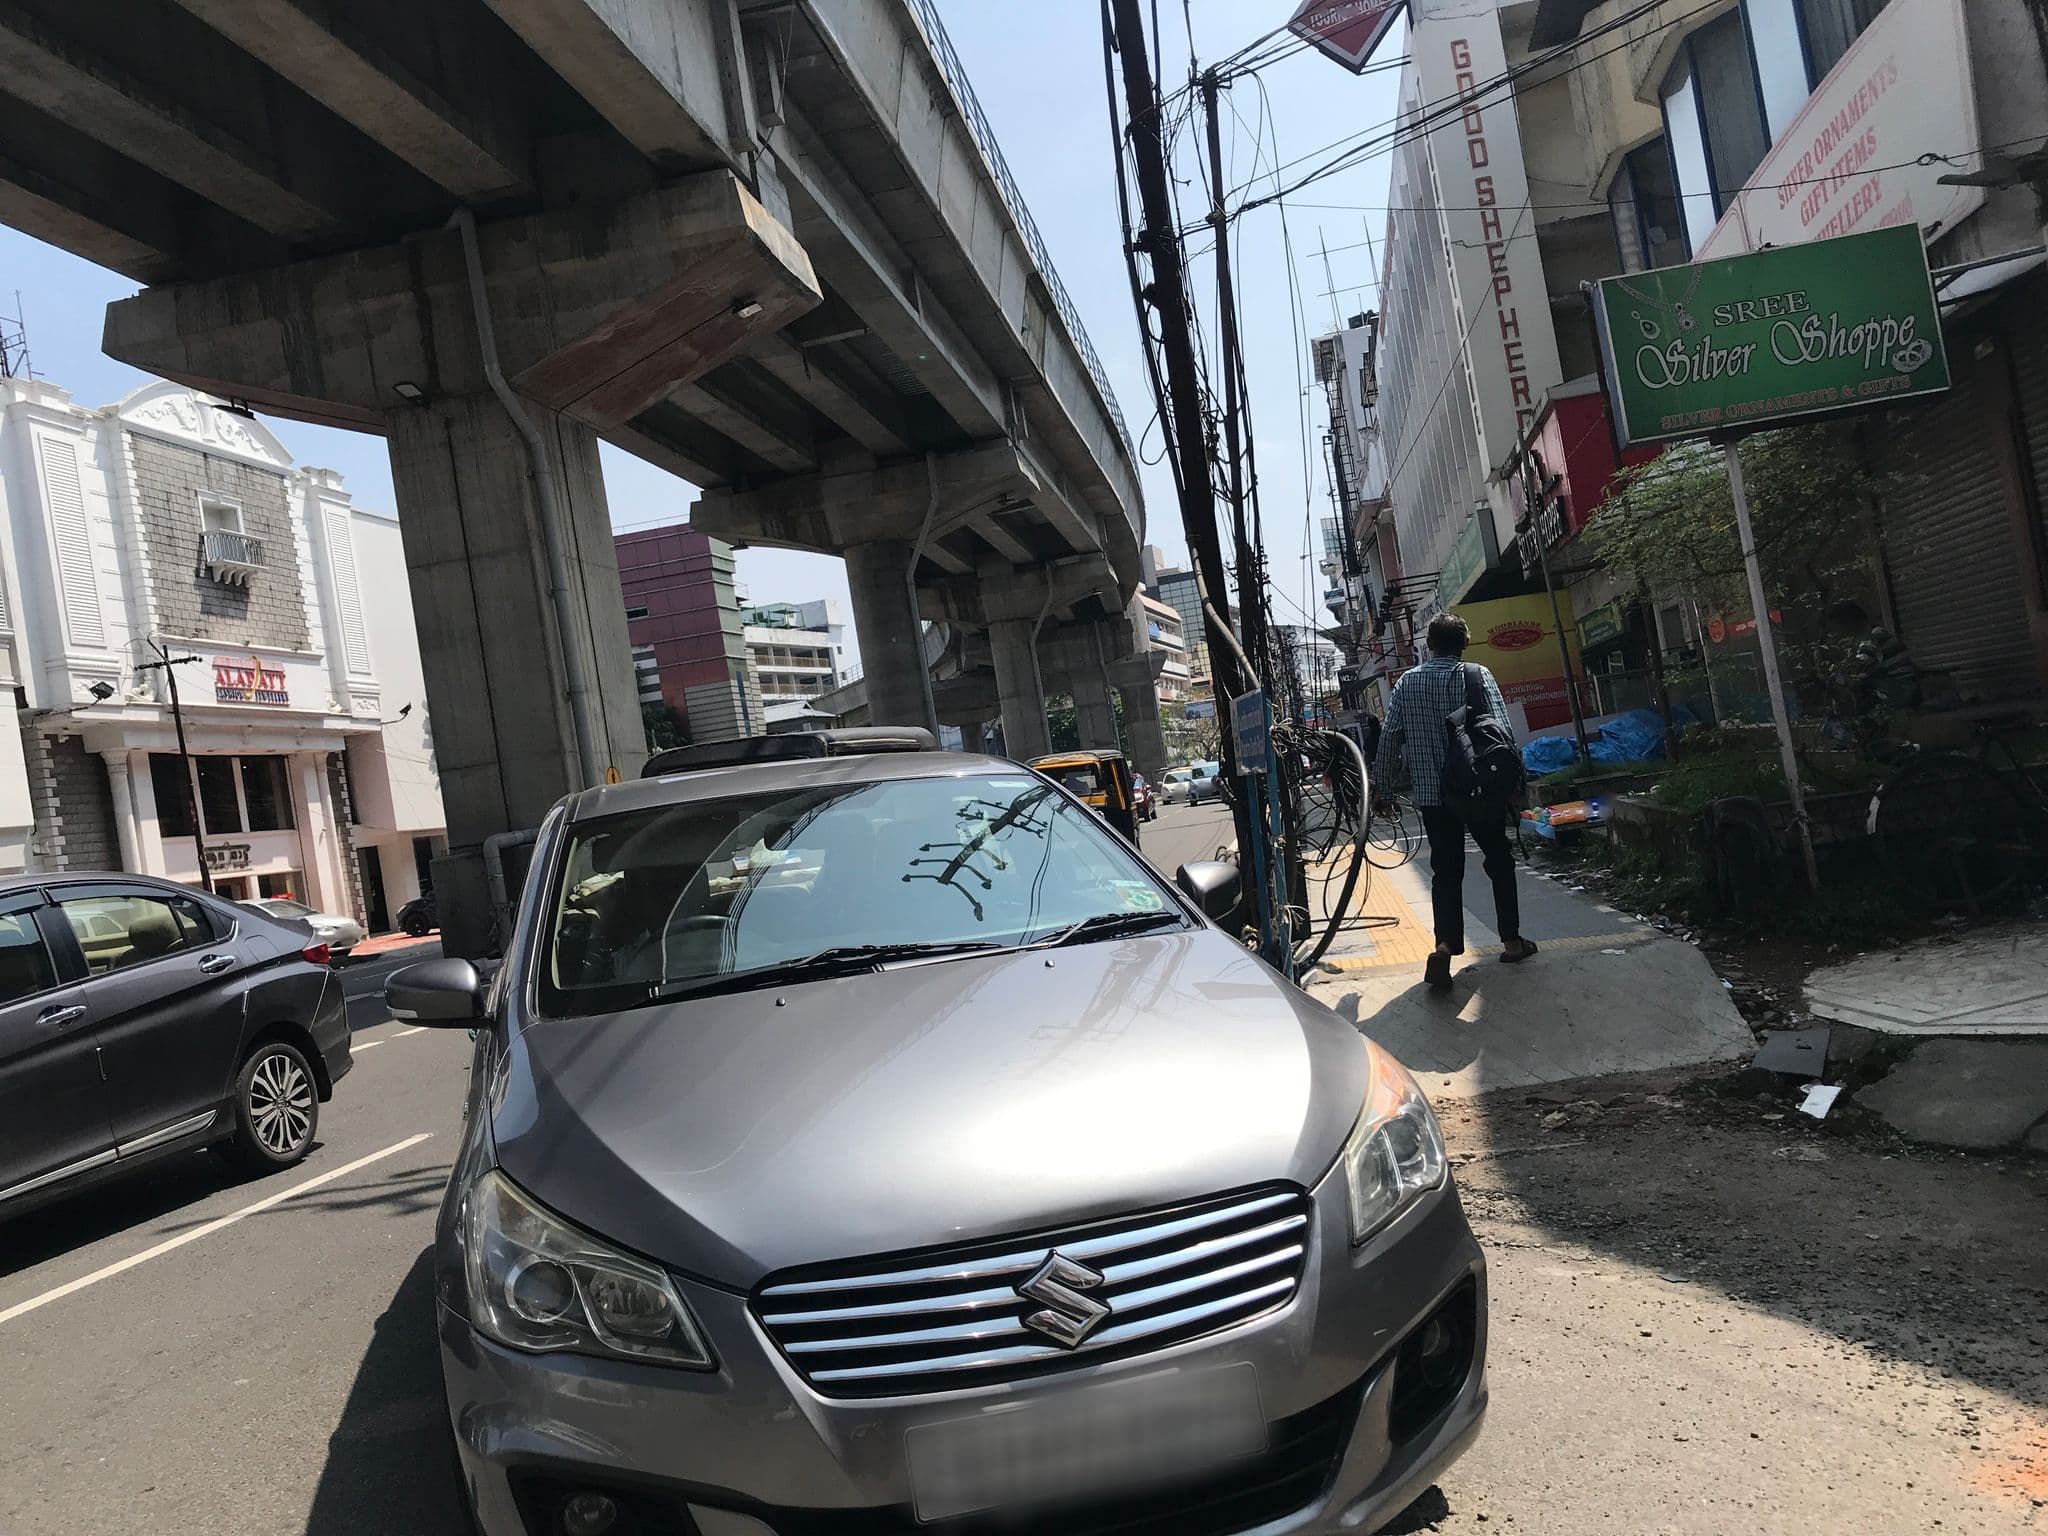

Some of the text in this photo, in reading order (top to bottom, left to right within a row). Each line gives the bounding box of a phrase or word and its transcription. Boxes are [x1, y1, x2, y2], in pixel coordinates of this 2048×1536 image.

[1450, 38, 1489, 169] GOOD
[1777, 150, 1816, 210] SILVER
[1813, 58, 1898, 166] ORNAMENTS
[1800, 126, 1878, 227] GIFT ITEMS
[1713, 290, 1811, 327] SREE
[1635, 313, 1916, 389] Silver Shoppe
[1661, 374, 1911, 430] SILVER ORNAMENTS & GIFTS
[1487, 620, 1543, 635] WOODLANDS
